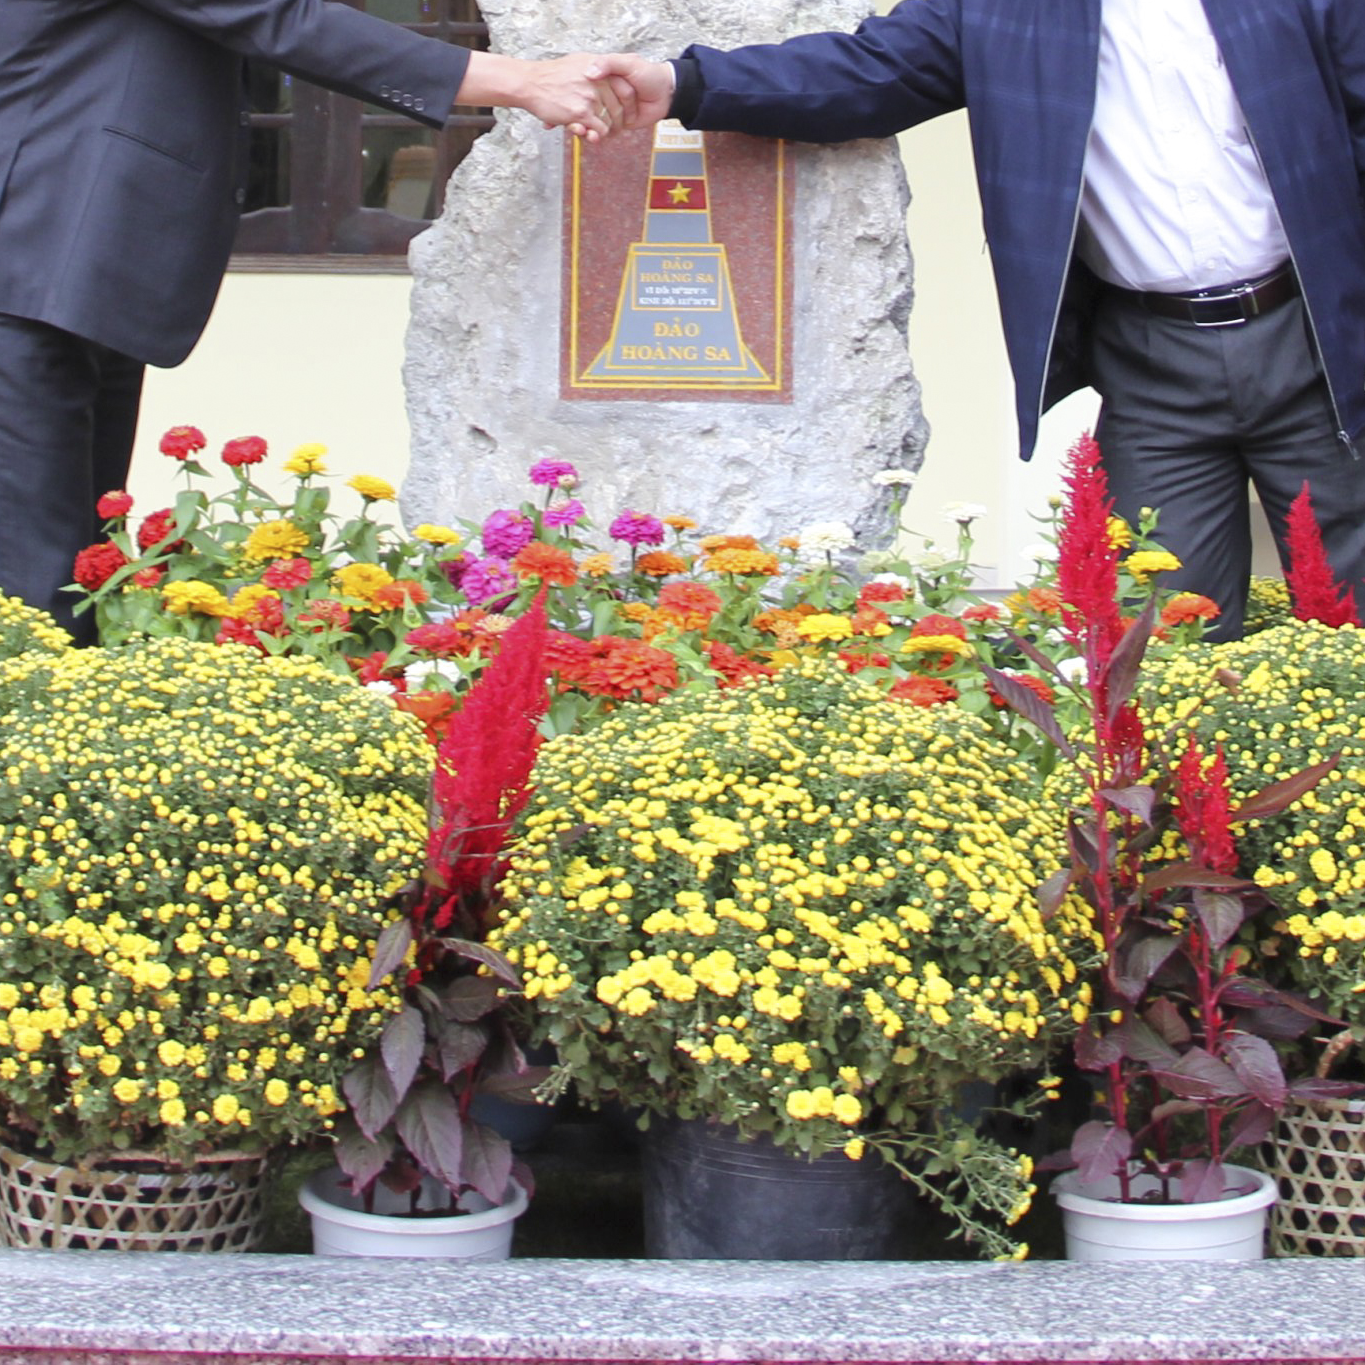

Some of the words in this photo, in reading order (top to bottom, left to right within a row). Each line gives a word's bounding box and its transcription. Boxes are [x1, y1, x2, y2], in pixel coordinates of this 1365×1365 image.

[662, 256, 694, 270] ĐẢO
[640, 270, 692, 284] HOÀNG
[696, 273, 716, 284] SA
[653, 317, 700, 338] ĐẢO
[620, 341, 700, 361] HOÀNG
[704, 345, 732, 361] SA
